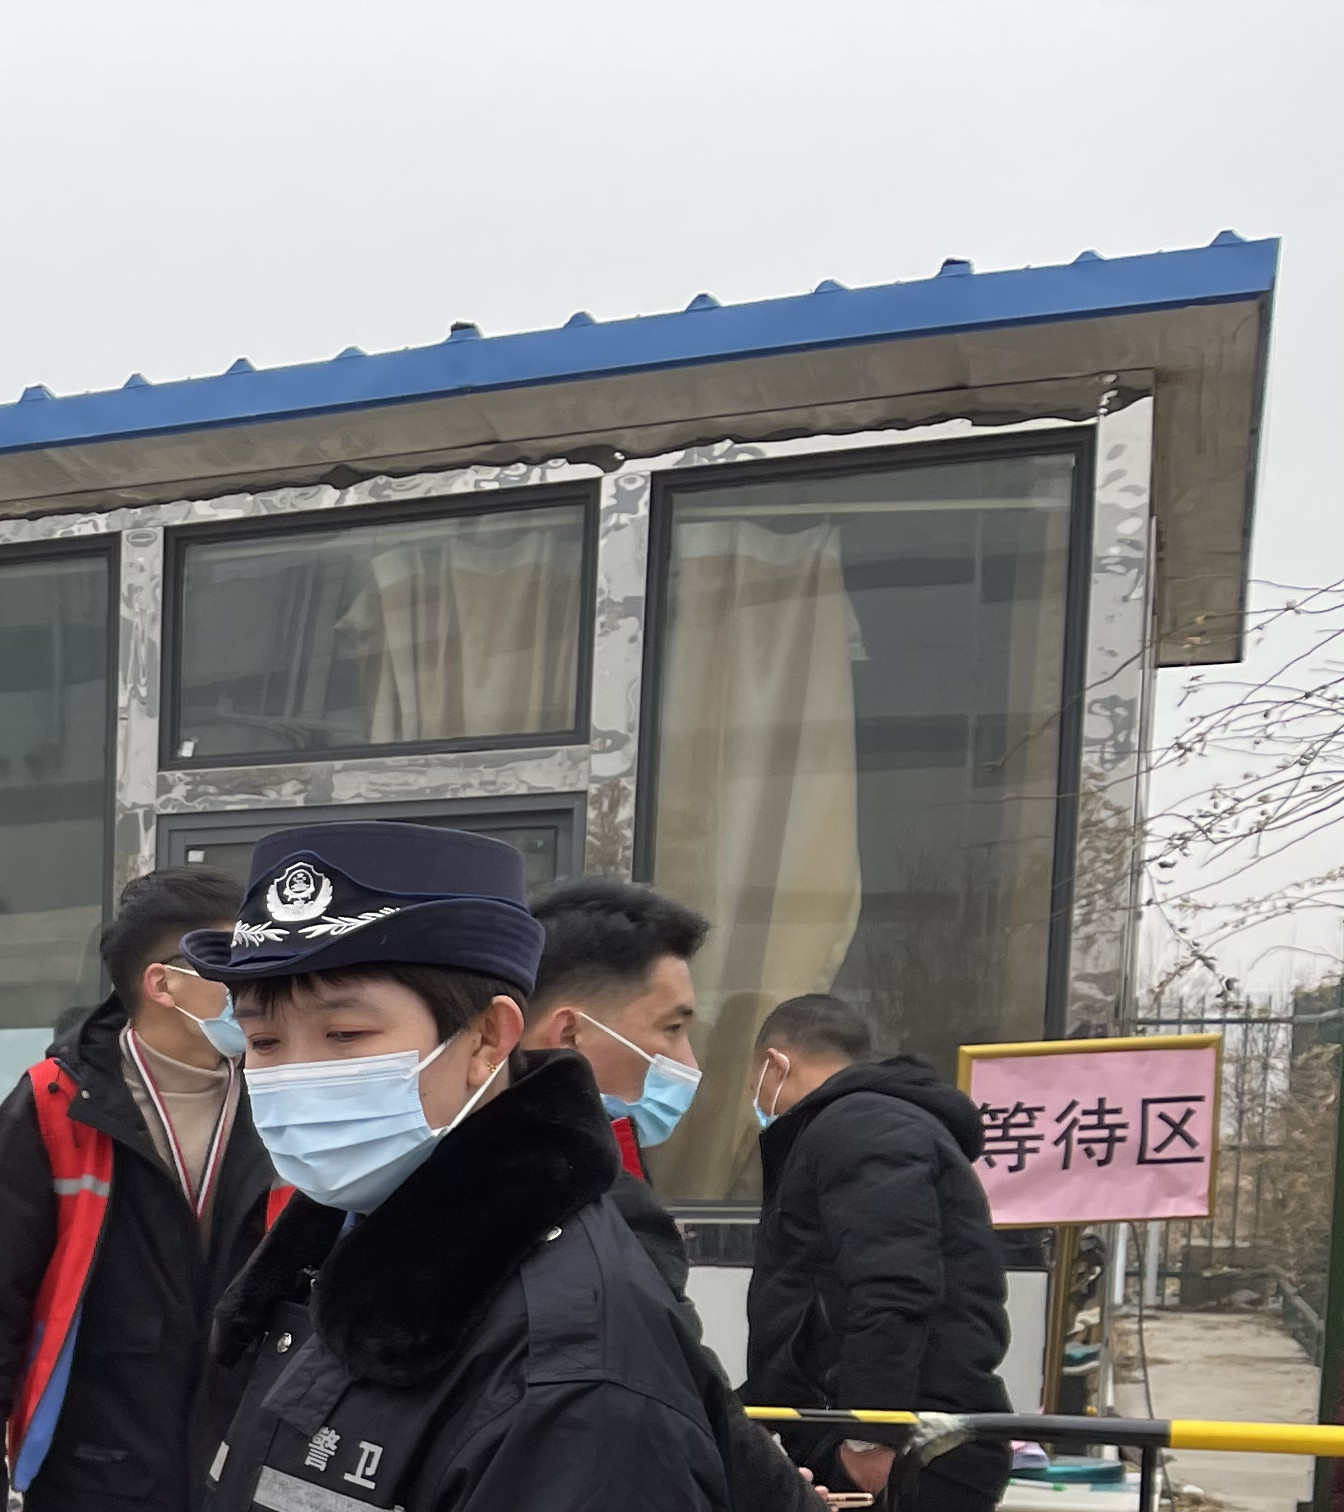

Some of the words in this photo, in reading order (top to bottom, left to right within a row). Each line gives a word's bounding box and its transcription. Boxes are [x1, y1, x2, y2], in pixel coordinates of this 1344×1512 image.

[979, 1095, 1206, 1173] 等待区
[304, 1425, 384, 1491] 警卫
